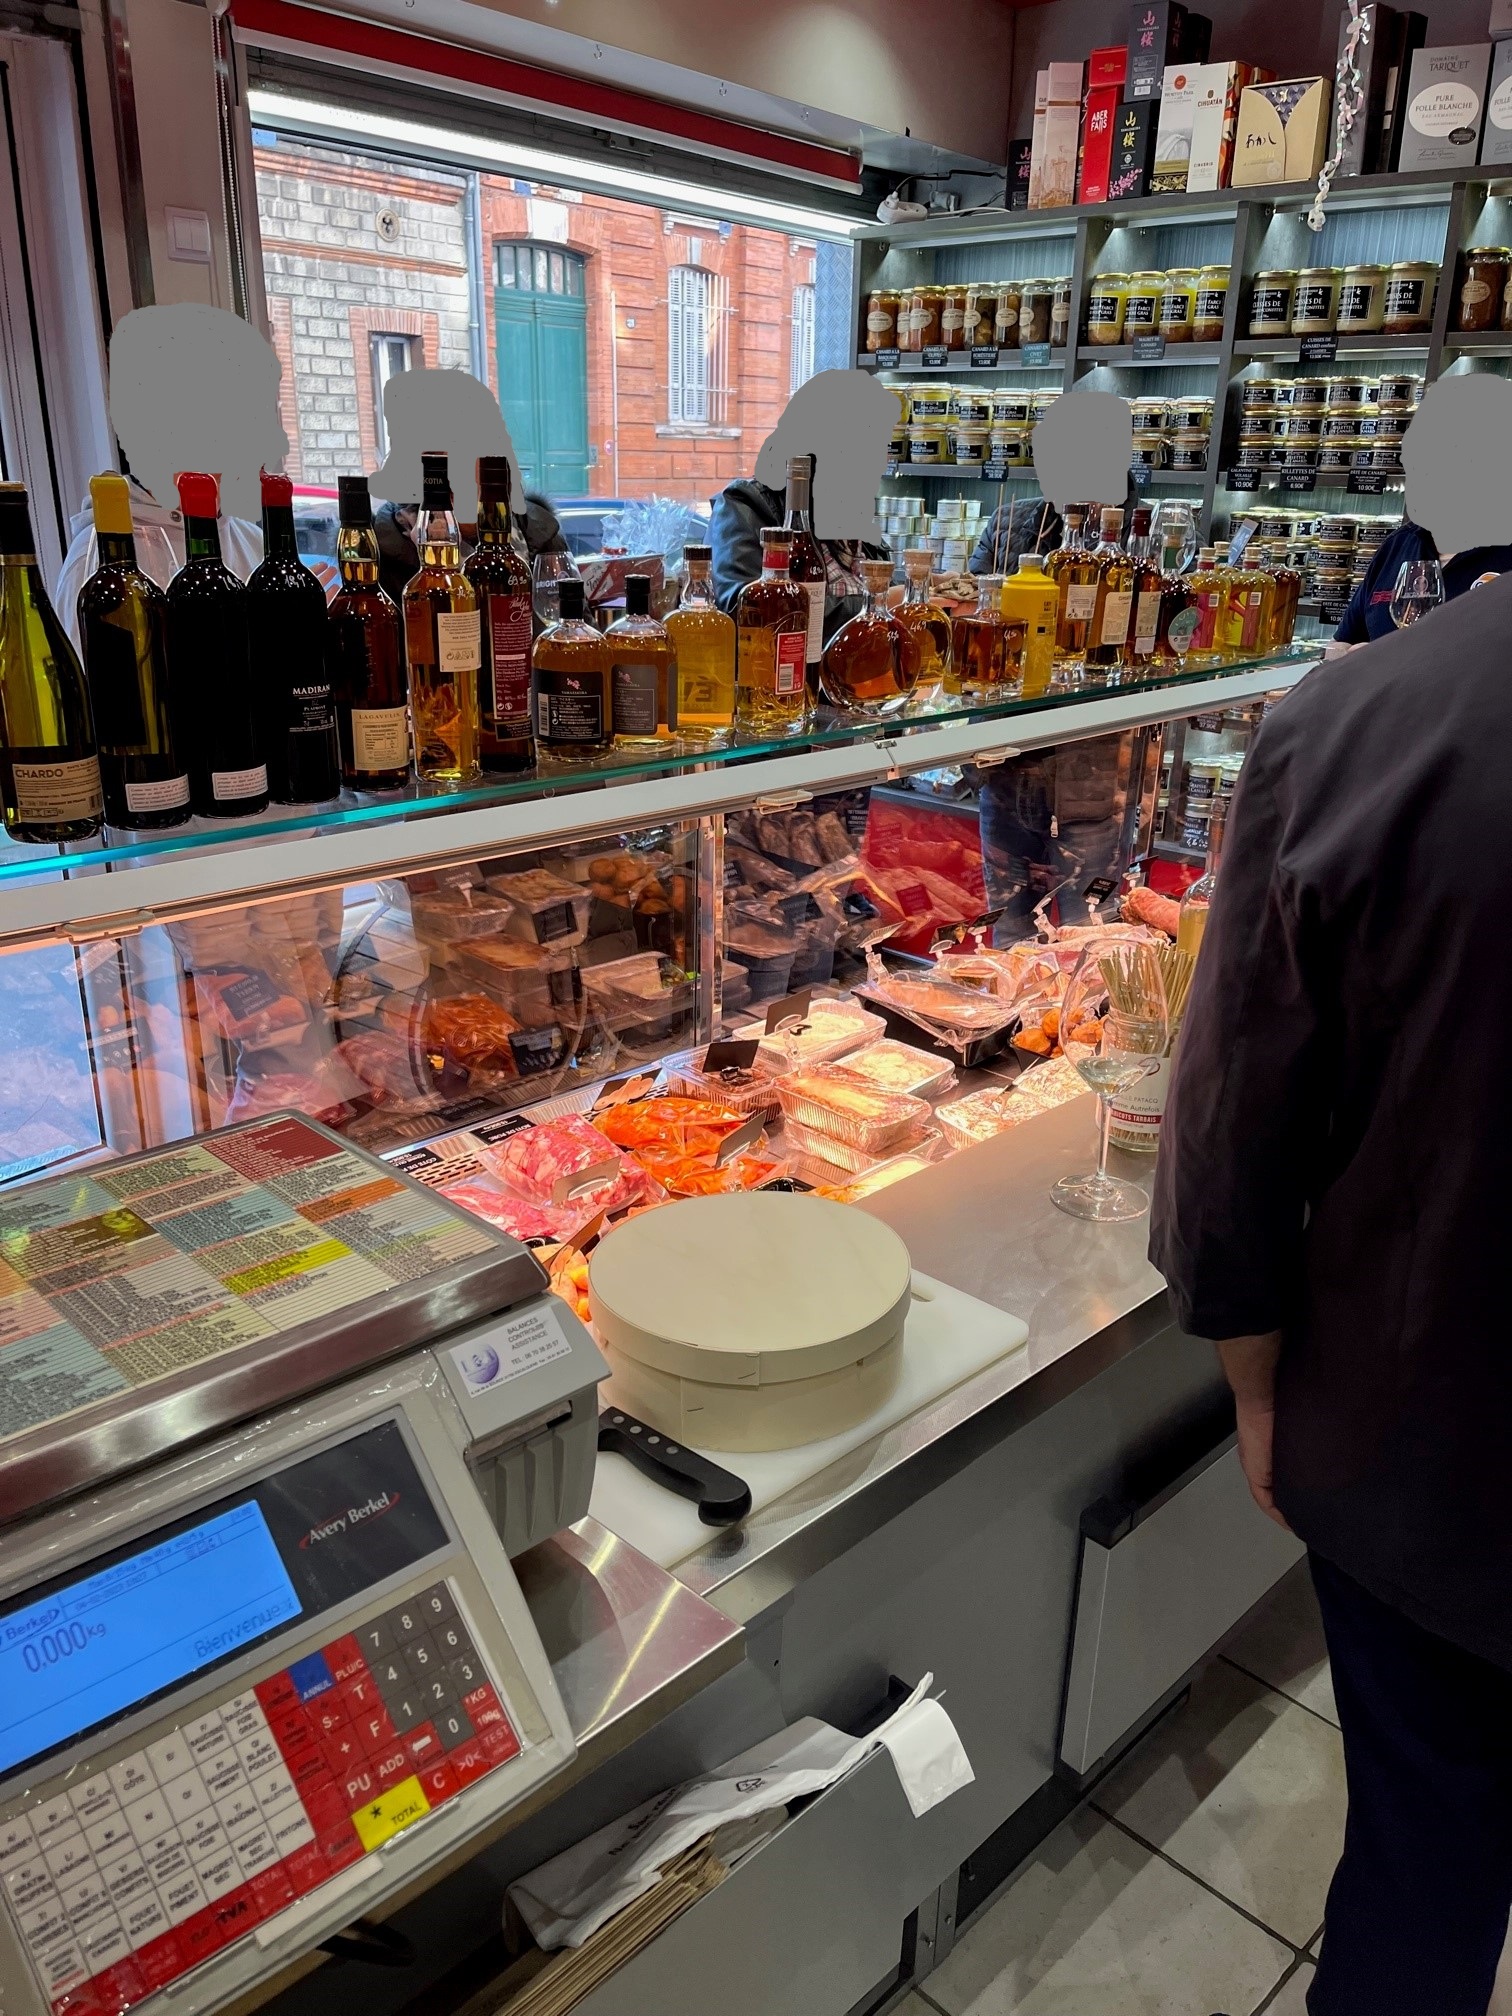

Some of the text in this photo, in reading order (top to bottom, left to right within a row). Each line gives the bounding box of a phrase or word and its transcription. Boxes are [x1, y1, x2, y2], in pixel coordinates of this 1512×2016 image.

[1429, 61, 1470, 73] TARIQUET
[1435, 94, 1455, 102] PURE
[1415, 102, 1473, 112] FOLLE BLANCHE
[1091, 109, 1108, 121] ABER
[292, 683, 331, 695] MADIRAN
[15, 769, 64, 779] CHARDO
[1133, 1096, 1159, 1104] PATACQ
[1130, 1103, 1160, 1113] Autrefois
[1132, 1112, 1157, 1123] TARBAIS
[508, 1317, 537, 1334] BALANCES
[512, 1331, 547, 1350] ASSISTANCE
[310, 1491, 390, 1545] Avery Berkel
[431, 1598, 442, 1613] 9
[5, 1611, 53, 1640] Berkel
[401, 1615, 412, 1630] 8
[194, 1606, 283, 1657] Bienvenue
[446, 1632, 457, 1646] 6
[20, 1619, 108, 1673] 0.000 kg
[371, 1633, 381, 1647] 7
[417, 1649, 427, 1663] 5
[335, 1659, 365, 1680] PLU/C
[386, 1667, 397, 1682] 4
[462, 1666, 473, 1680] 3
[302, 1679, 332, 1699] ANNUL
[354, 1685, 366, 1701] T
[432, 1683, 444, 1699] 2
[402, 1703, 412, 1717] 1
[370, 1722, 381, 1736] F
[448, 1719, 459, 1733] 0
[484, 1726, 510, 1745] TEST
[246, 1744, 272, 1762] BLANC
[248, 1752, 278, 1772] POULET
[378, 1754, 404, 1777] ADD
[347, 1775, 371, 1797] PU
[433, 1774, 445, 1789] C
[390, 1802, 422, 1825] TOTAL
[185, 1823, 221, 1846] SAUCISSE
[237, 1832, 267, 1852] MAGRET
[201, 1857, 235, 1880] MAGRET
